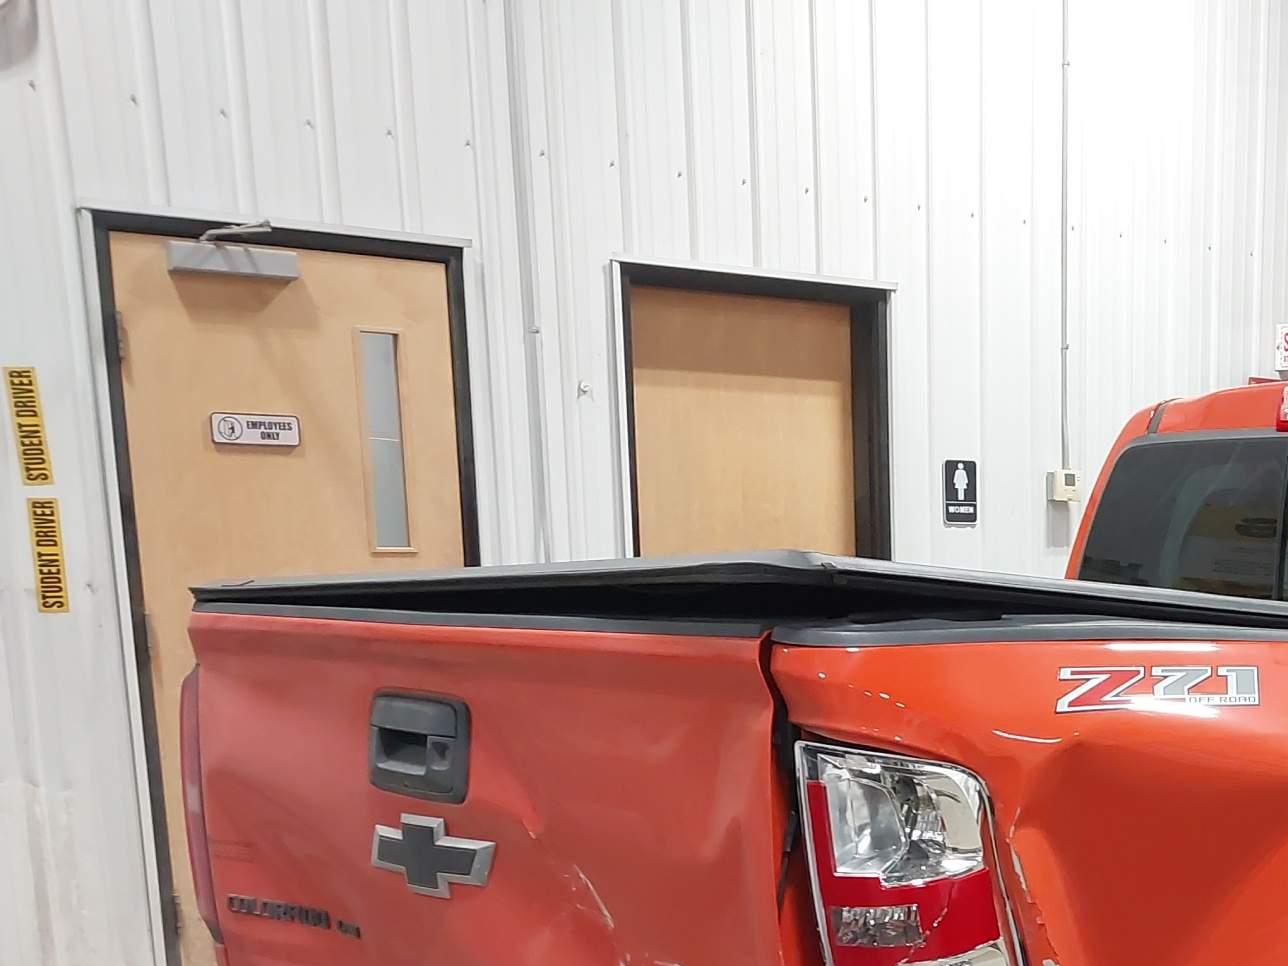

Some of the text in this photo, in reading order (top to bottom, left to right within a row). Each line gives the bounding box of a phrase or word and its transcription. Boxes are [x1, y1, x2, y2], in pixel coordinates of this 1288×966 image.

[9, 369, 49, 482] STUDENT DRIVER
[246, 420, 293, 431] EMPLOYEES
[260, 431, 280, 441] ONLY
[948, 505, 975, 514] WOMEN
[31, 500, 65, 609] STUDENT DRIVER
[1055, 666, 1260, 714] Z71
